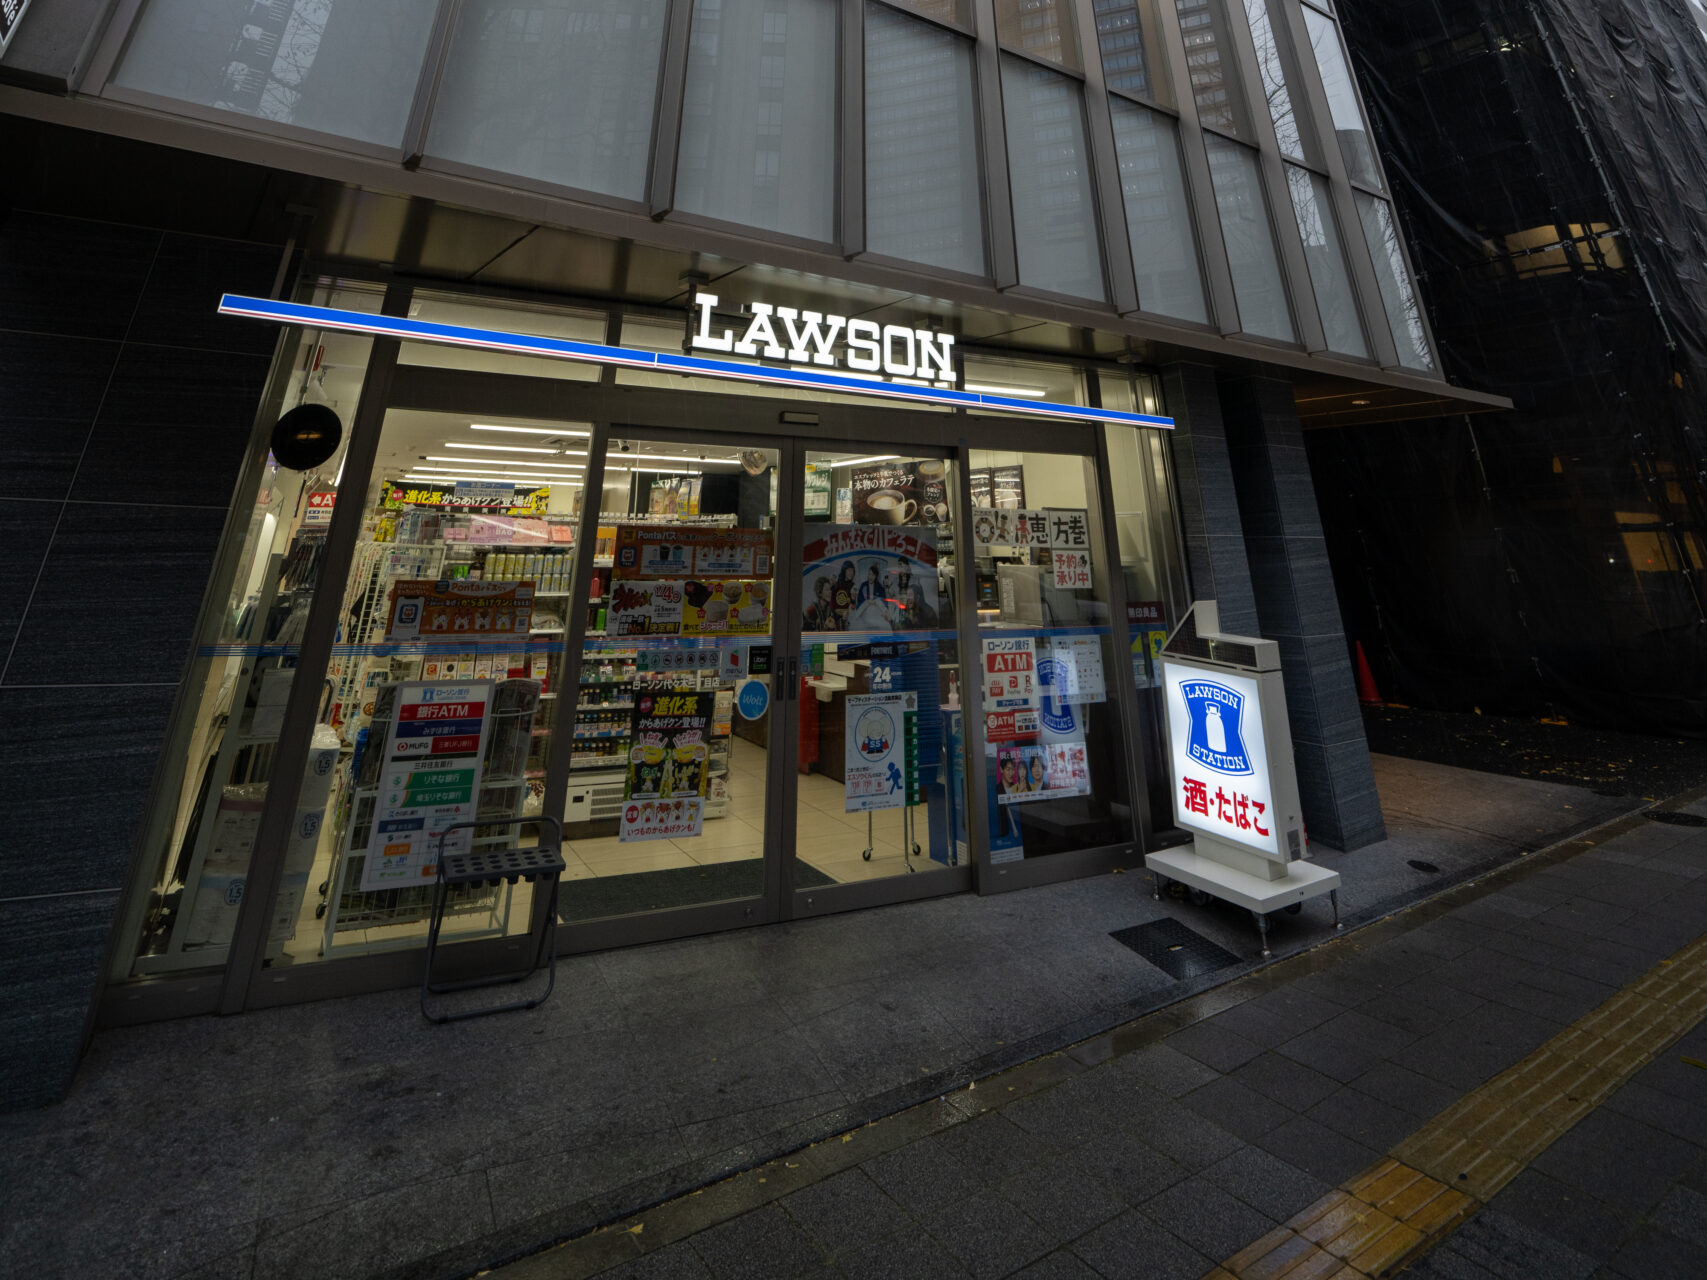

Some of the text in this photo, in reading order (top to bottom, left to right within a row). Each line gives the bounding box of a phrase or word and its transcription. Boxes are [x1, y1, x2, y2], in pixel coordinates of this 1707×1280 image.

[692, 292, 957, 382] LAWSON
[853, 474, 915, 491] 本物のカフェラテ
[1055, 552, 1077, 570] 予約
[1056, 571, 1089, 586] 承り中
[987, 639, 1030, 651] ローソン銀行
[993, 654, 1028, 672] ATM
[873, 666, 892, 683] 24
[436, 688, 470, 697] ローソン銀行
[742, 693, 764, 706] Wolt
[1185, 686, 1239, 710] LAWSON
[416, 704, 469, 719] 銀行ATM
[652, 695, 699, 716] 進化系
[638, 716, 706, 729] からあげクン登場!!
[997, 716, 1014, 726] ATM
[422, 726, 456, 735] みずほ銀行
[408, 742, 429, 750] MUFG
[1192, 743, 1246, 770] STATION
[414, 760, 453, 770] 三井住友銀行
[424, 773, 461, 785] りそな銀行
[1182, 776, 1270, 837] 酒・たばこ
[627, 823, 696, 837] いつものからあげクンも!
